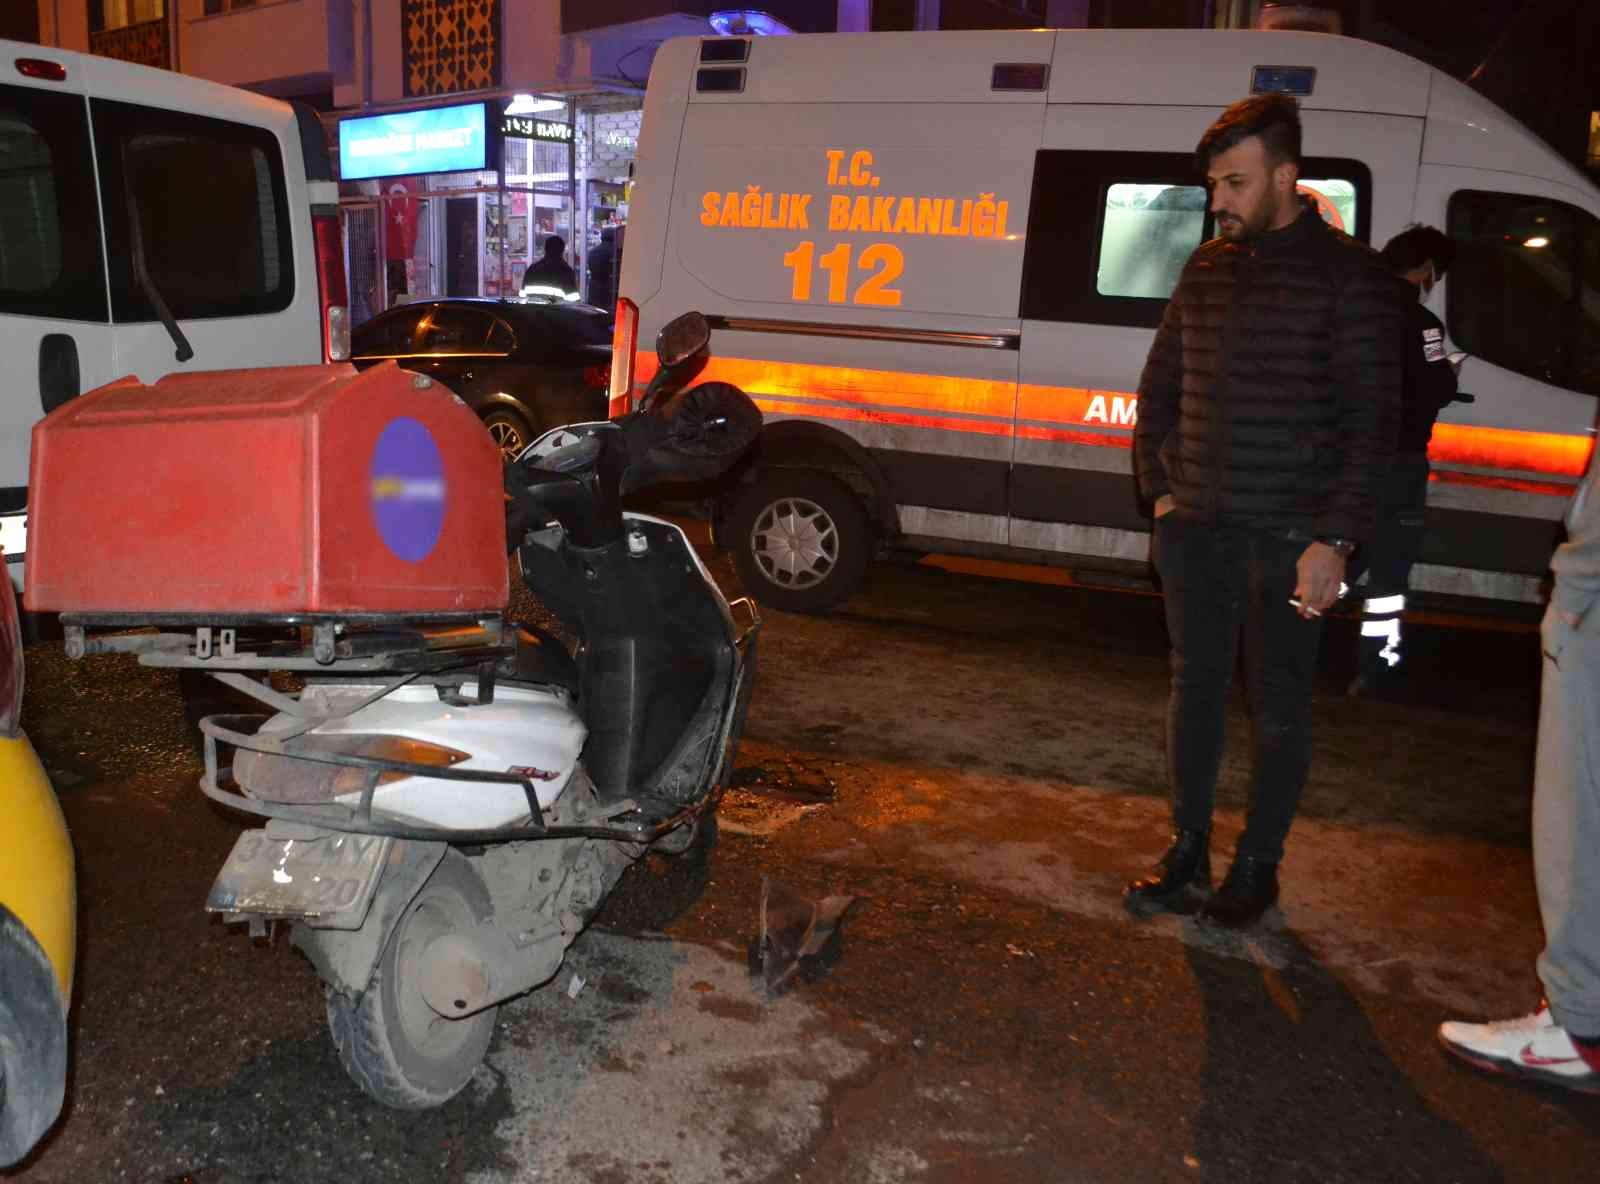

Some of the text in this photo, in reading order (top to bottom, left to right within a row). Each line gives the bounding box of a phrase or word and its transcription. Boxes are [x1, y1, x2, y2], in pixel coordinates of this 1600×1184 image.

[826, 149, 881, 188] T.C.
[700, 185, 1009, 238] SAĞLIK BAKANLIĞI
[784, 240, 905, 306] 112
